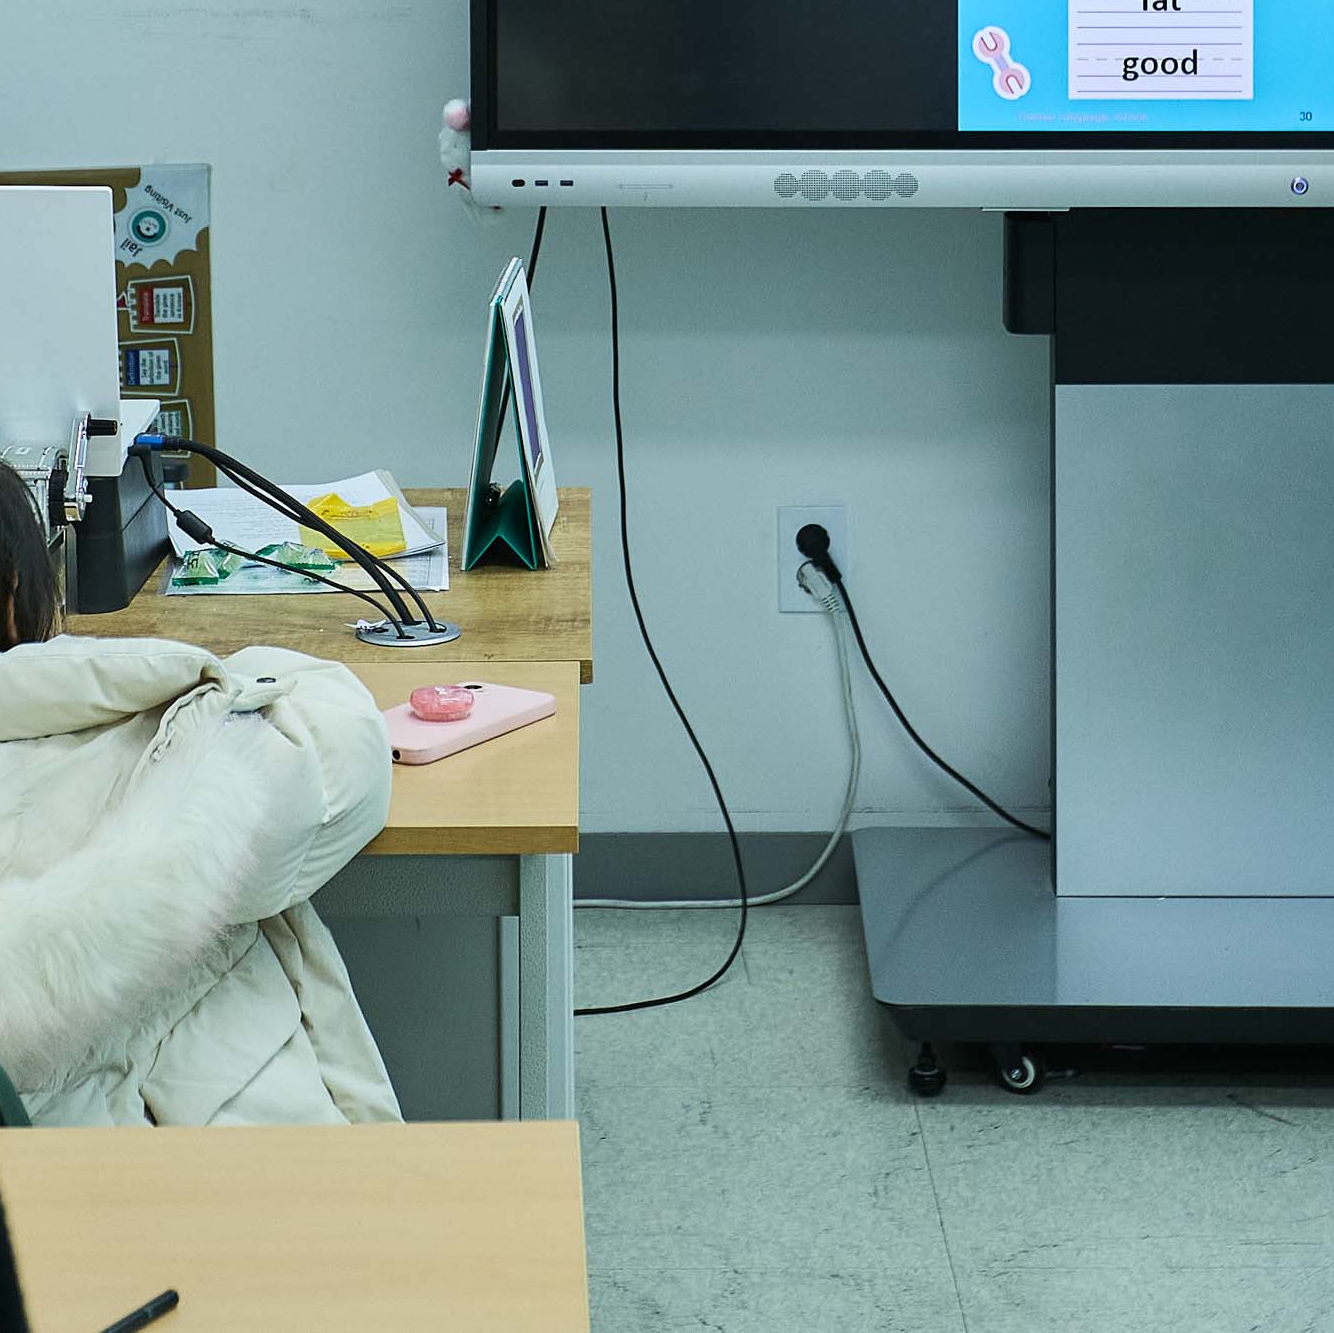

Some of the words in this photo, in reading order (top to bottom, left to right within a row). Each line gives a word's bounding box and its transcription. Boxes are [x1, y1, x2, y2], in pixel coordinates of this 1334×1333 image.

[1122, 48, 1199, 81] good
[1299, 111, 1313, 122] 30
[144, 184, 174, 212] Visiting
[174, 207, 192, 224] Just
[119, 238, 143, 257] Jail
